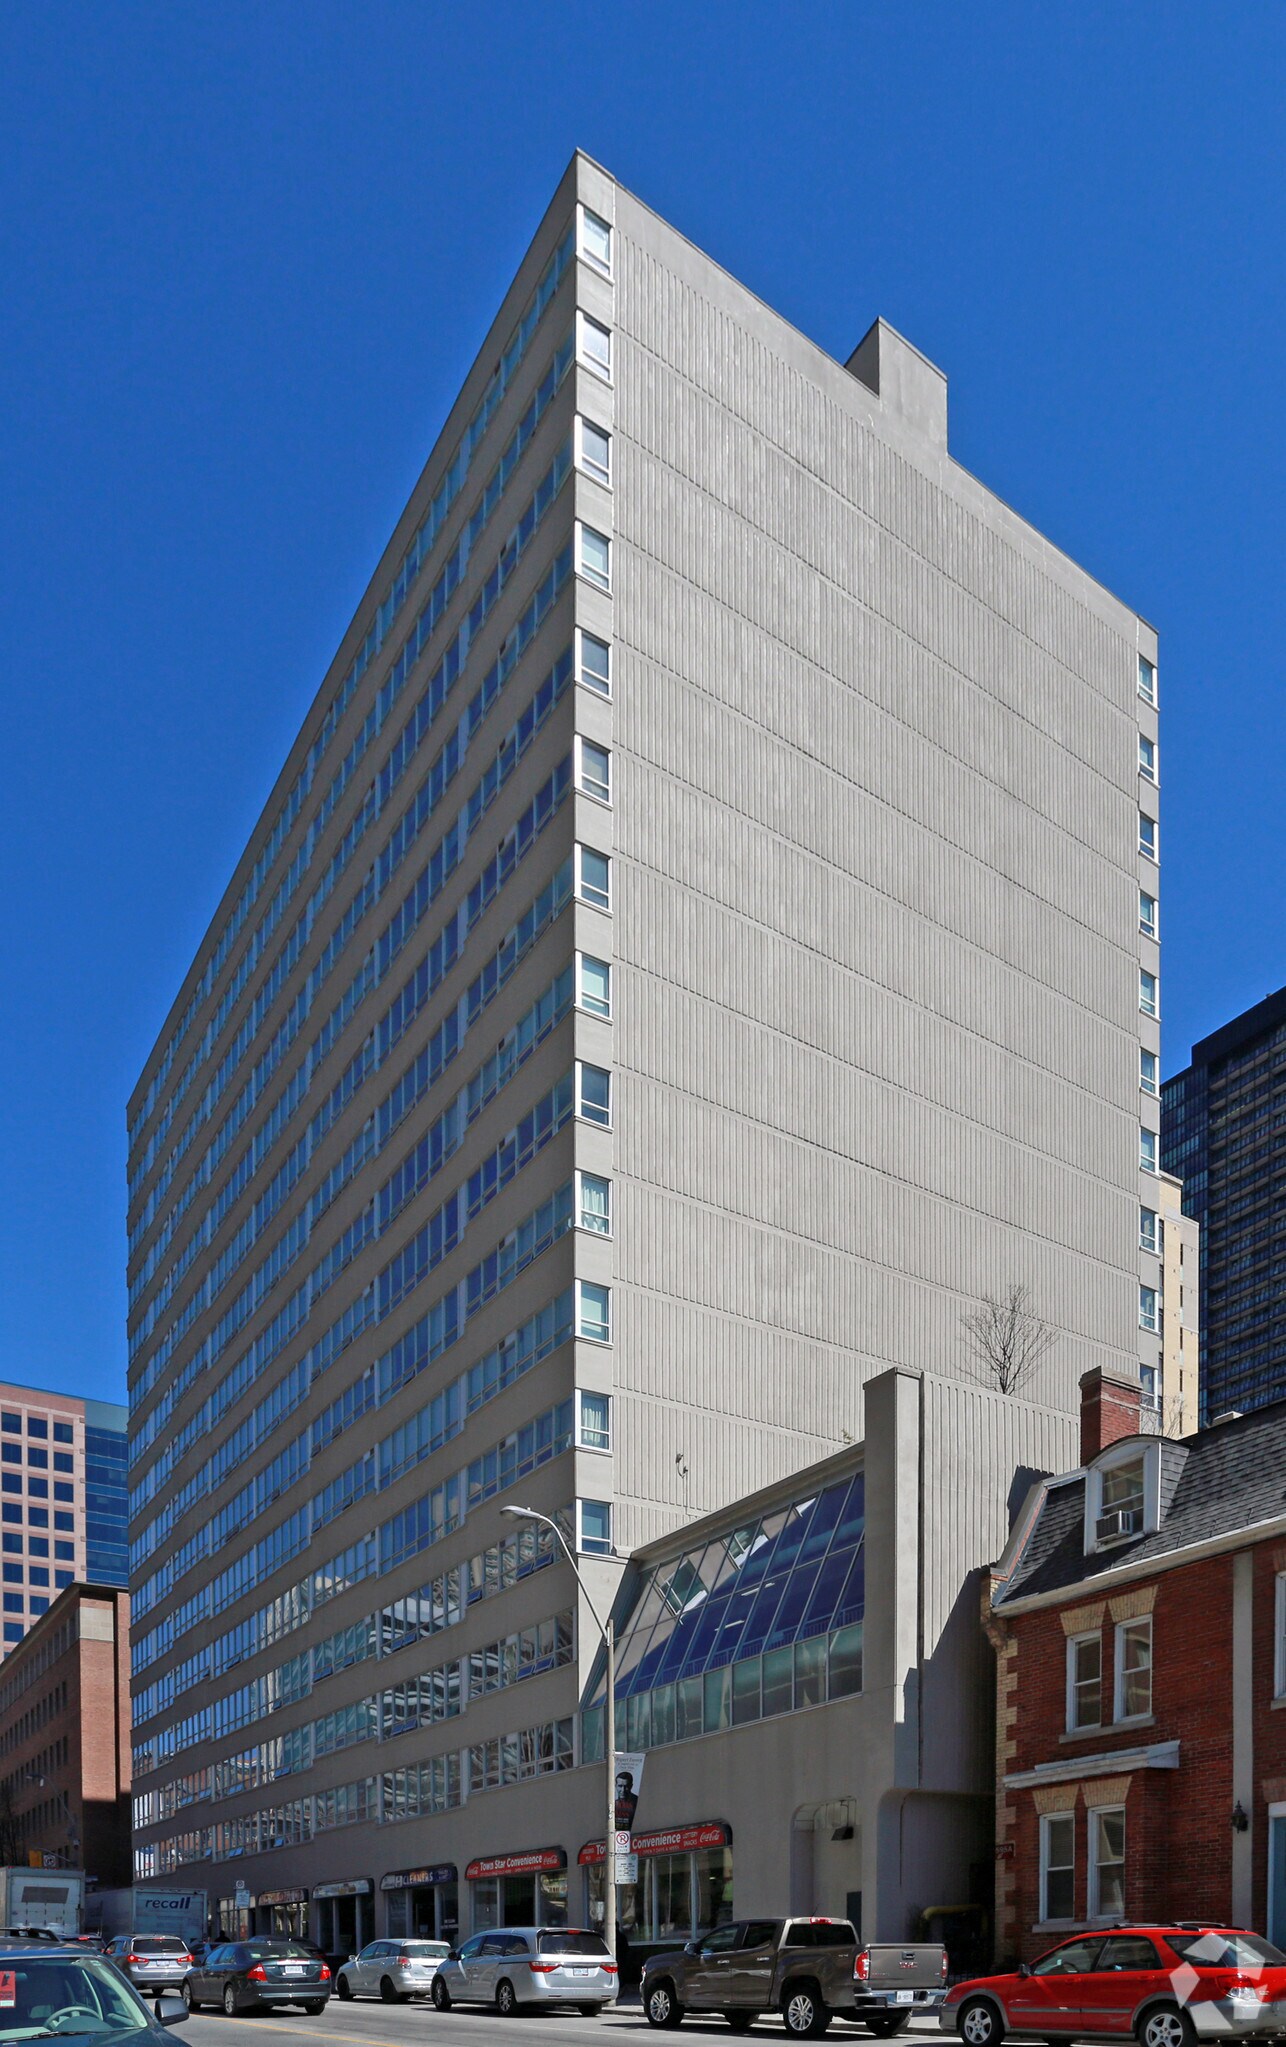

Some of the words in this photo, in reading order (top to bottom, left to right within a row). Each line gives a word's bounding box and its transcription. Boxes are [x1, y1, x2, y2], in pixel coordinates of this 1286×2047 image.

[631, 1833, 681, 1850] Convenience
[480, 1861, 494, 1871] Town
[494, 1859, 505, 1869] Star
[506, 1854, 543, 1868] Convenience
[145, 1896, 191, 1910] recall
